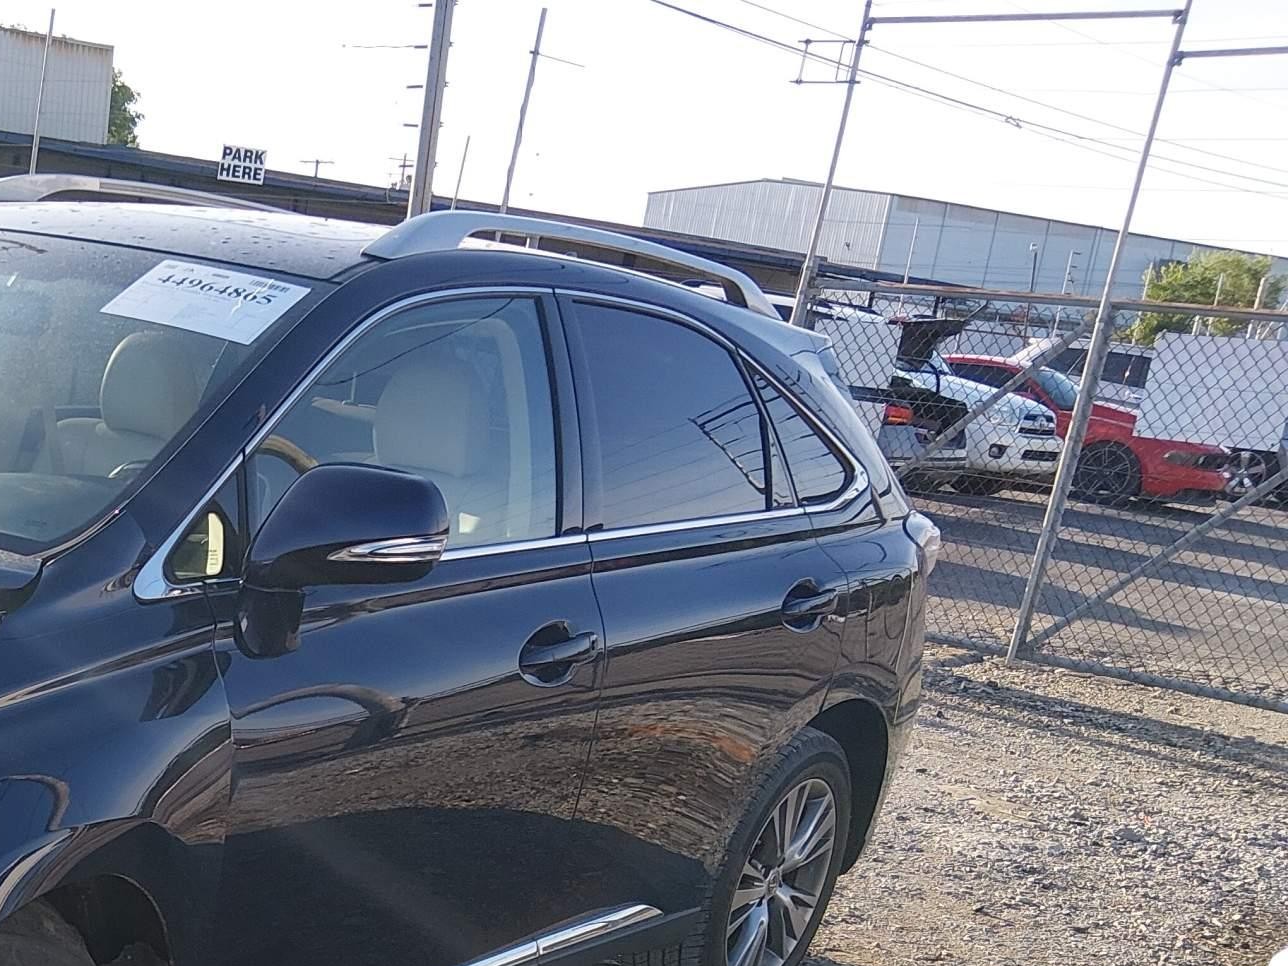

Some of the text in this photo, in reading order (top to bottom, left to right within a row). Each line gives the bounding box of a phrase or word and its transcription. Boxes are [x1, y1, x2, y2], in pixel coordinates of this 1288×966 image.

[222, 146, 264, 165] PARK
[219, 162, 263, 181] HERE
[158, 274, 277, 305] 44964865
